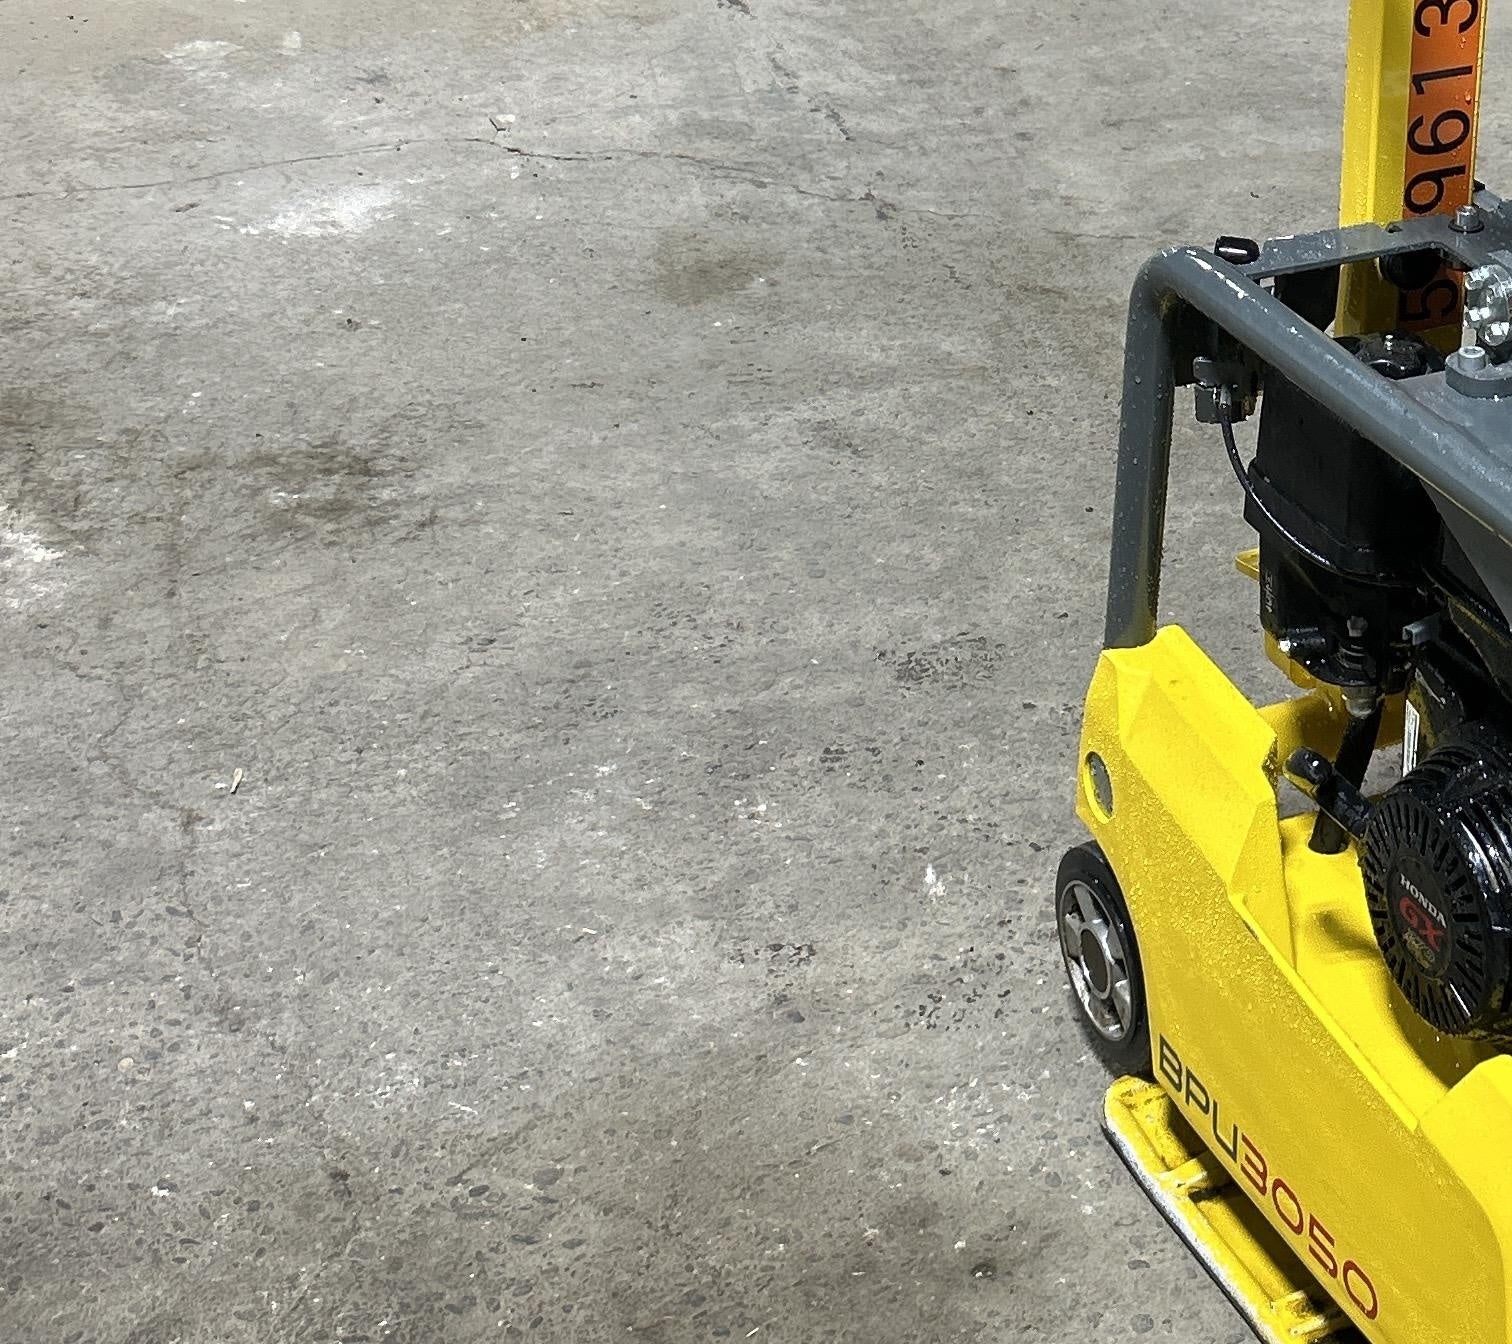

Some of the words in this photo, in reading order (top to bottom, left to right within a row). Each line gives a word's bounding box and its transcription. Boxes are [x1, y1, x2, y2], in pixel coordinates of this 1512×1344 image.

[1398, 895, 1448, 953] GX
[1400, 872, 1448, 929] HONDA
[1158, 1032, 1379, 1321] BPU3050
